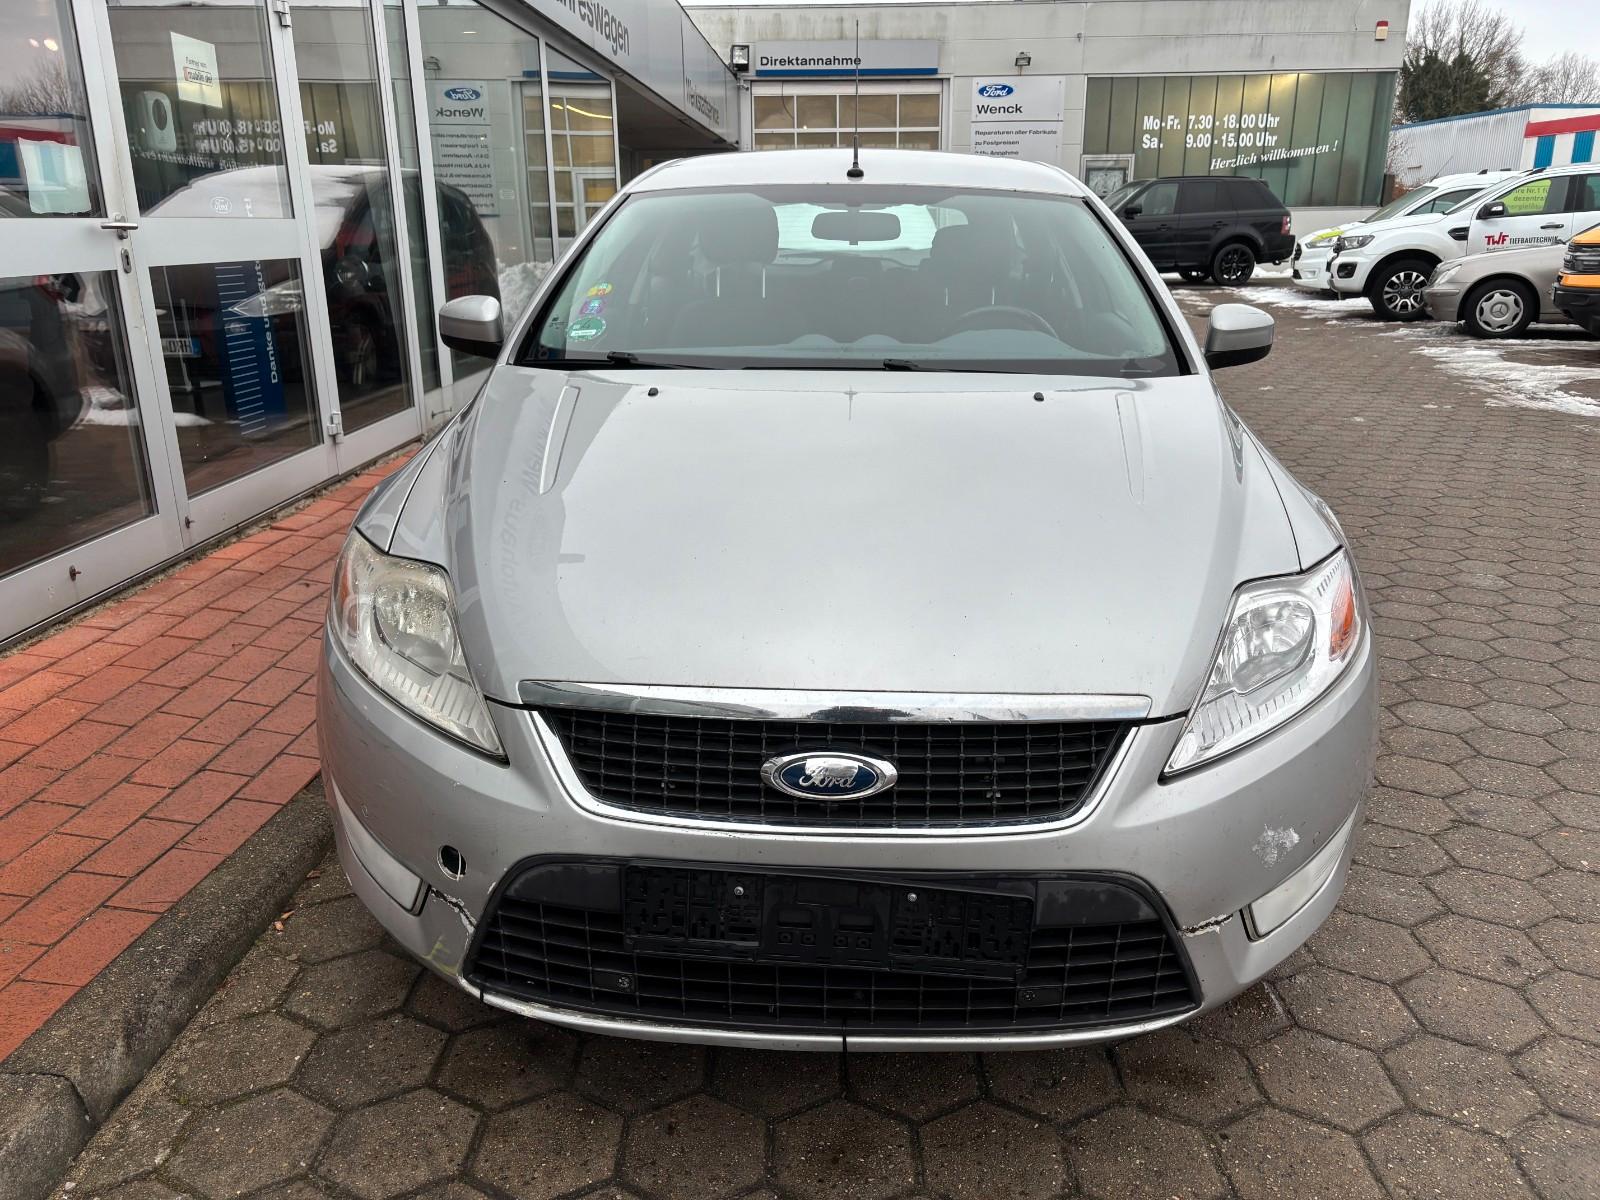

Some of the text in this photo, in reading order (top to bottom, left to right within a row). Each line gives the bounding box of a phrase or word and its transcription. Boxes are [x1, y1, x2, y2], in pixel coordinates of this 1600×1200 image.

[760, 56, 861, 66] Direktannahme
[981, 85, 1011, 97] Ford
[976, 103, 1023, 114] Wenck
[1188, 114, 1213, 129] 7.30
[1258, 113, 1280, 128] Uhr
[1142, 134, 1163, 148] Sa.
[1186, 133, 1211, 148] 9.00
[1256, 132, 1278, 147] Uhr
[1210, 140, 1339, 170] Herzlich willkommen !
[1485, 232, 1509, 246] TWF
[260, 295, 270, 329] und
[265, 331, 278, 384] Danke
[798, 762, 858, 788] Ford
